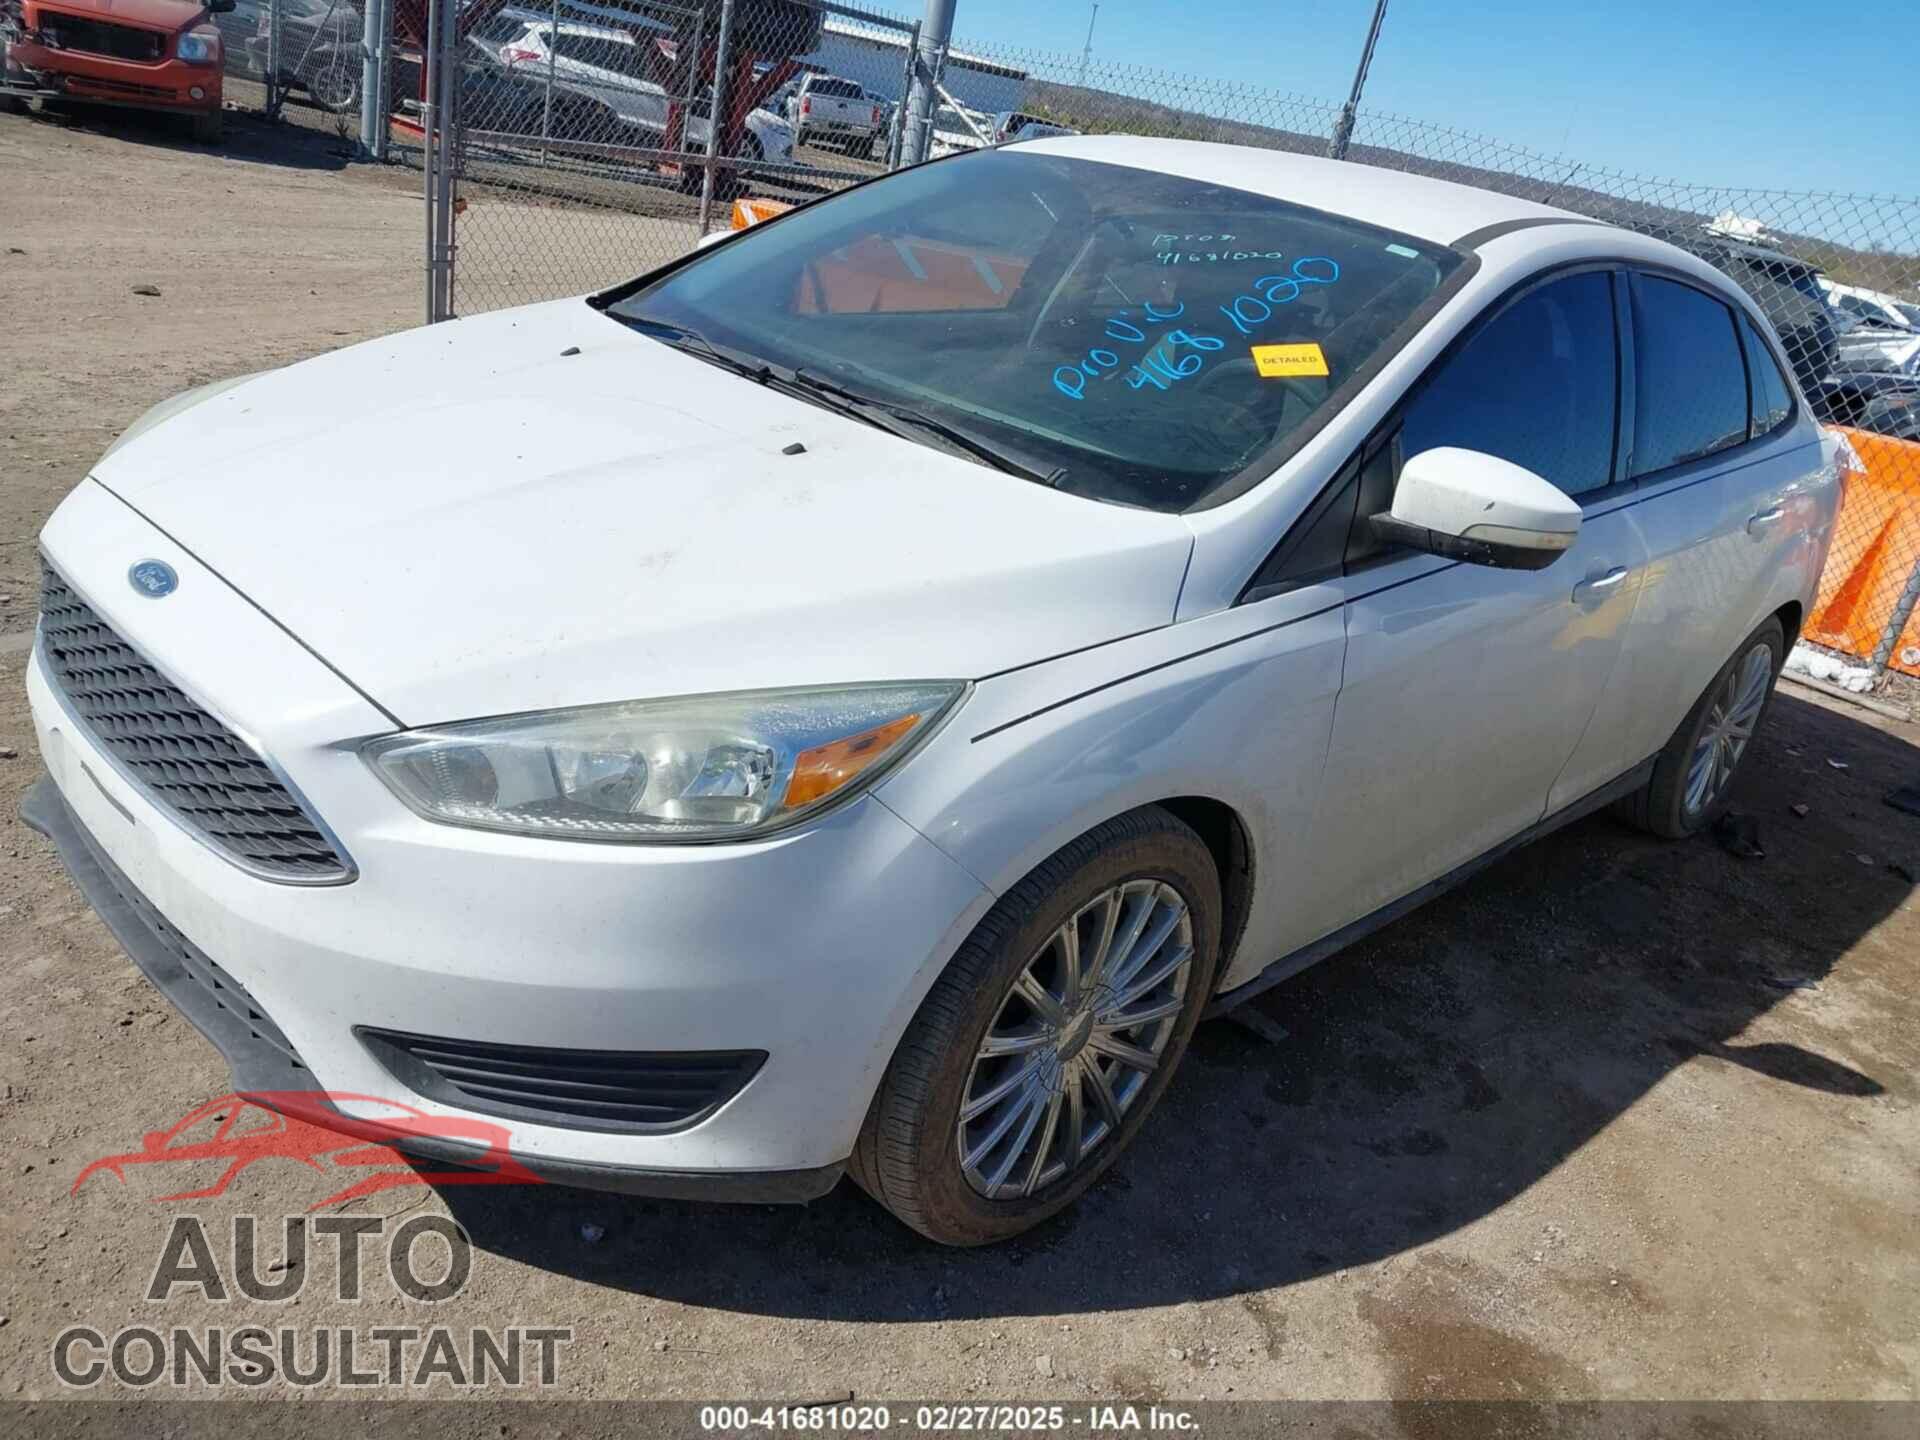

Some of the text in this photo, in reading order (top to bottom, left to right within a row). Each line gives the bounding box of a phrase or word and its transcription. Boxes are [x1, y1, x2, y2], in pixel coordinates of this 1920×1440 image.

[1156, 250, 1282, 264] 41681020
[1262, 355, 1319, 365] DETAILED
[135, 566, 168, 591] Ford
